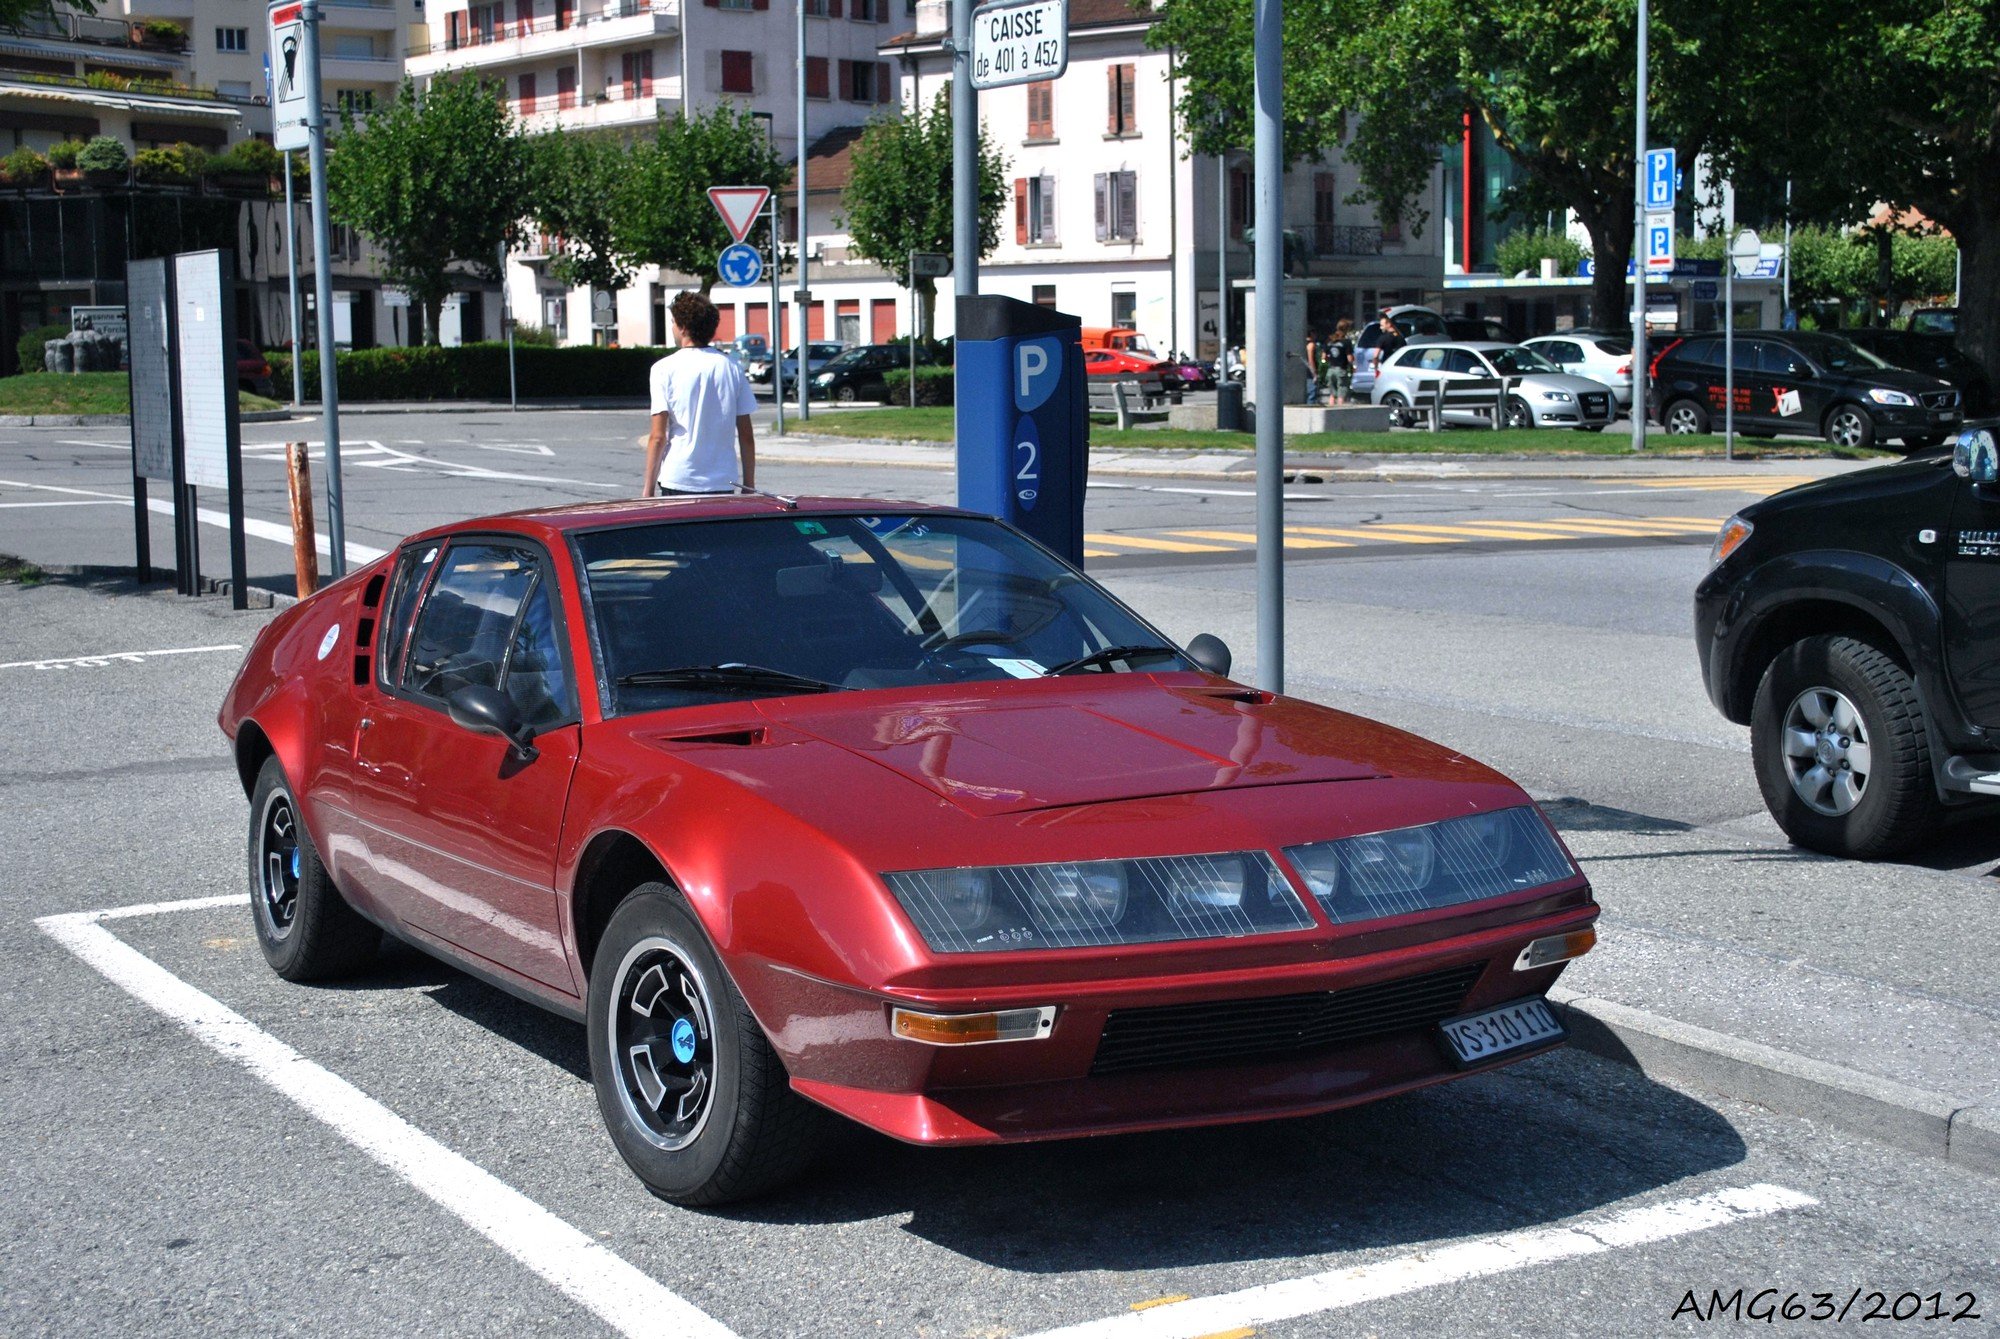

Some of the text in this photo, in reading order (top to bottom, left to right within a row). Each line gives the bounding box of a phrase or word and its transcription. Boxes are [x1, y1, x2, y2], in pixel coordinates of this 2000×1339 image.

[991, 9, 1043, 42] CAISSE
[976, 39, 1058, 77] de 401 à 452
[1654, 154, 1668, 182] P
[1019, 345, 1048, 396] P
[1016, 441, 1037, 480] 2
